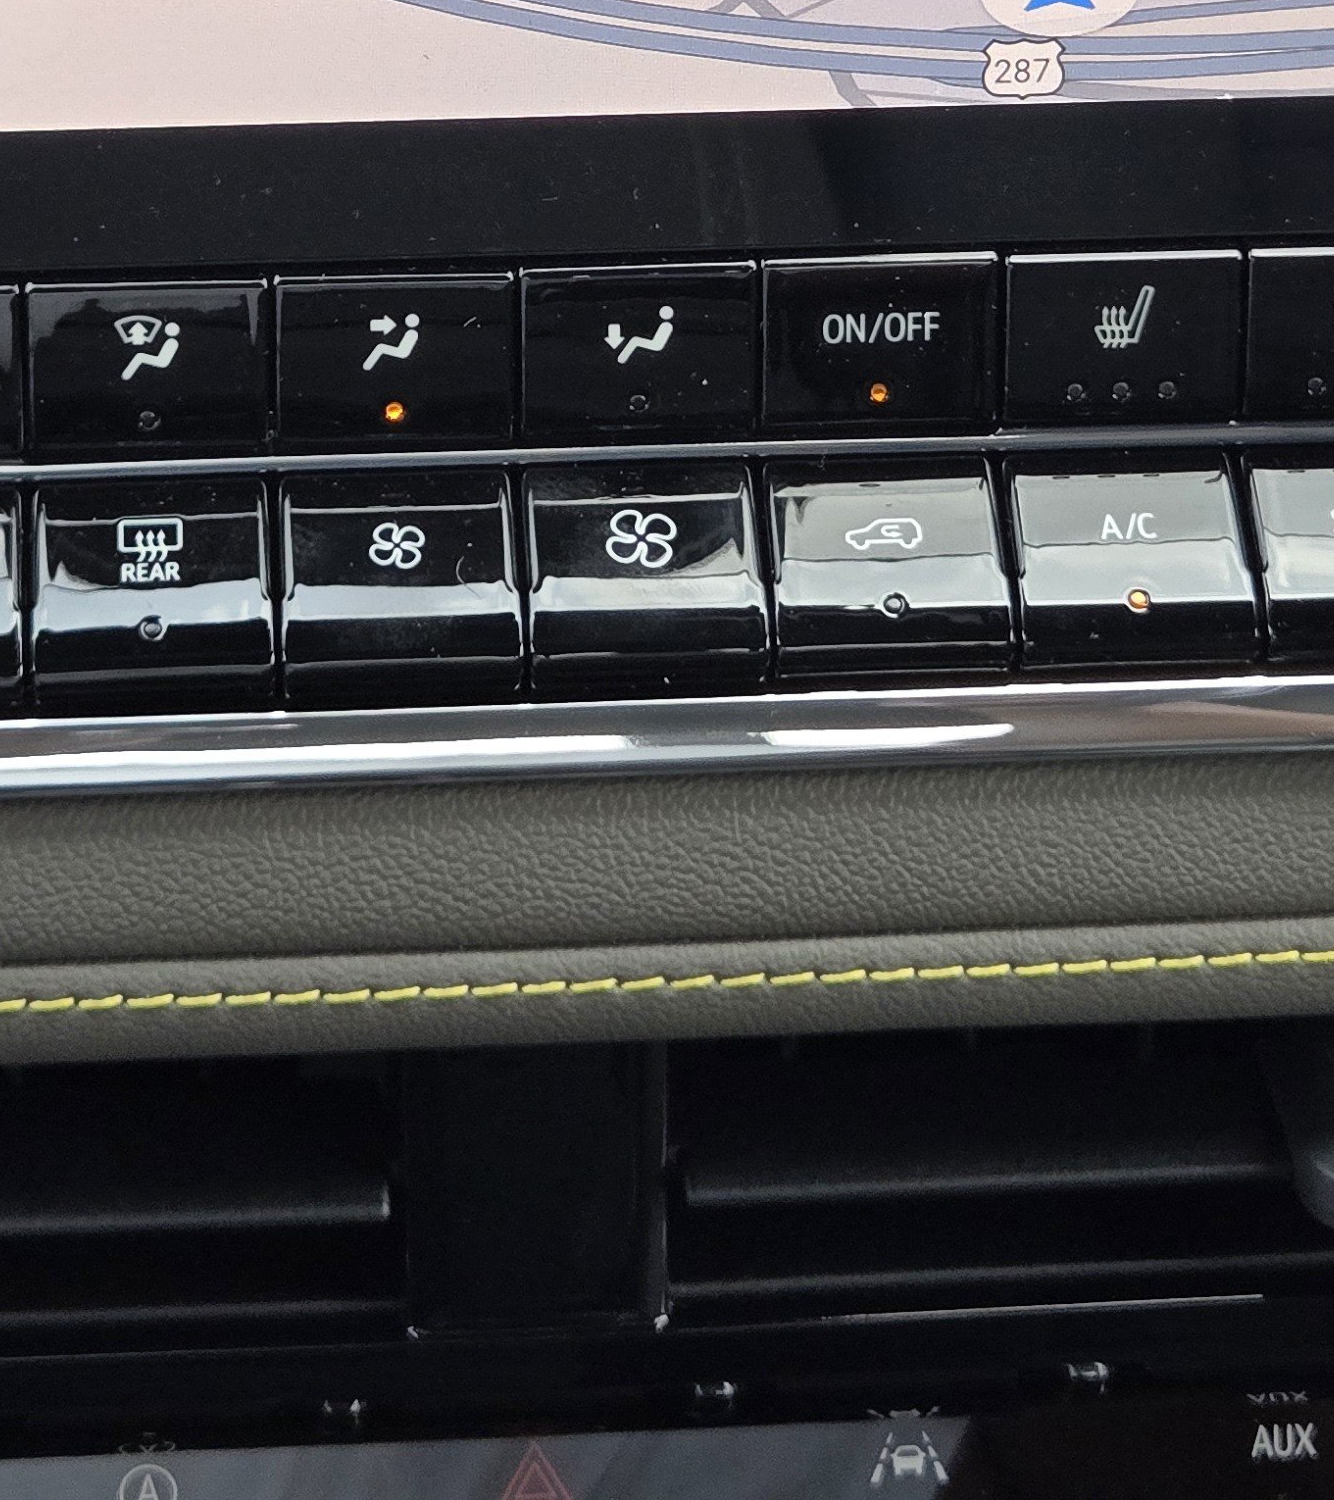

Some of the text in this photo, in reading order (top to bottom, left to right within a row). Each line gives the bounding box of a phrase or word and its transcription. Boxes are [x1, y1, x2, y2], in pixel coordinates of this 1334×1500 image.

[994, 59, 1051, 85] 287
[822, 311, 939, 346] ON/OFF
[1100, 513, 1157, 540] A/C
[120, 561, 180, 583] REAR
[1251, 1422, 1318, 1458] AUX
